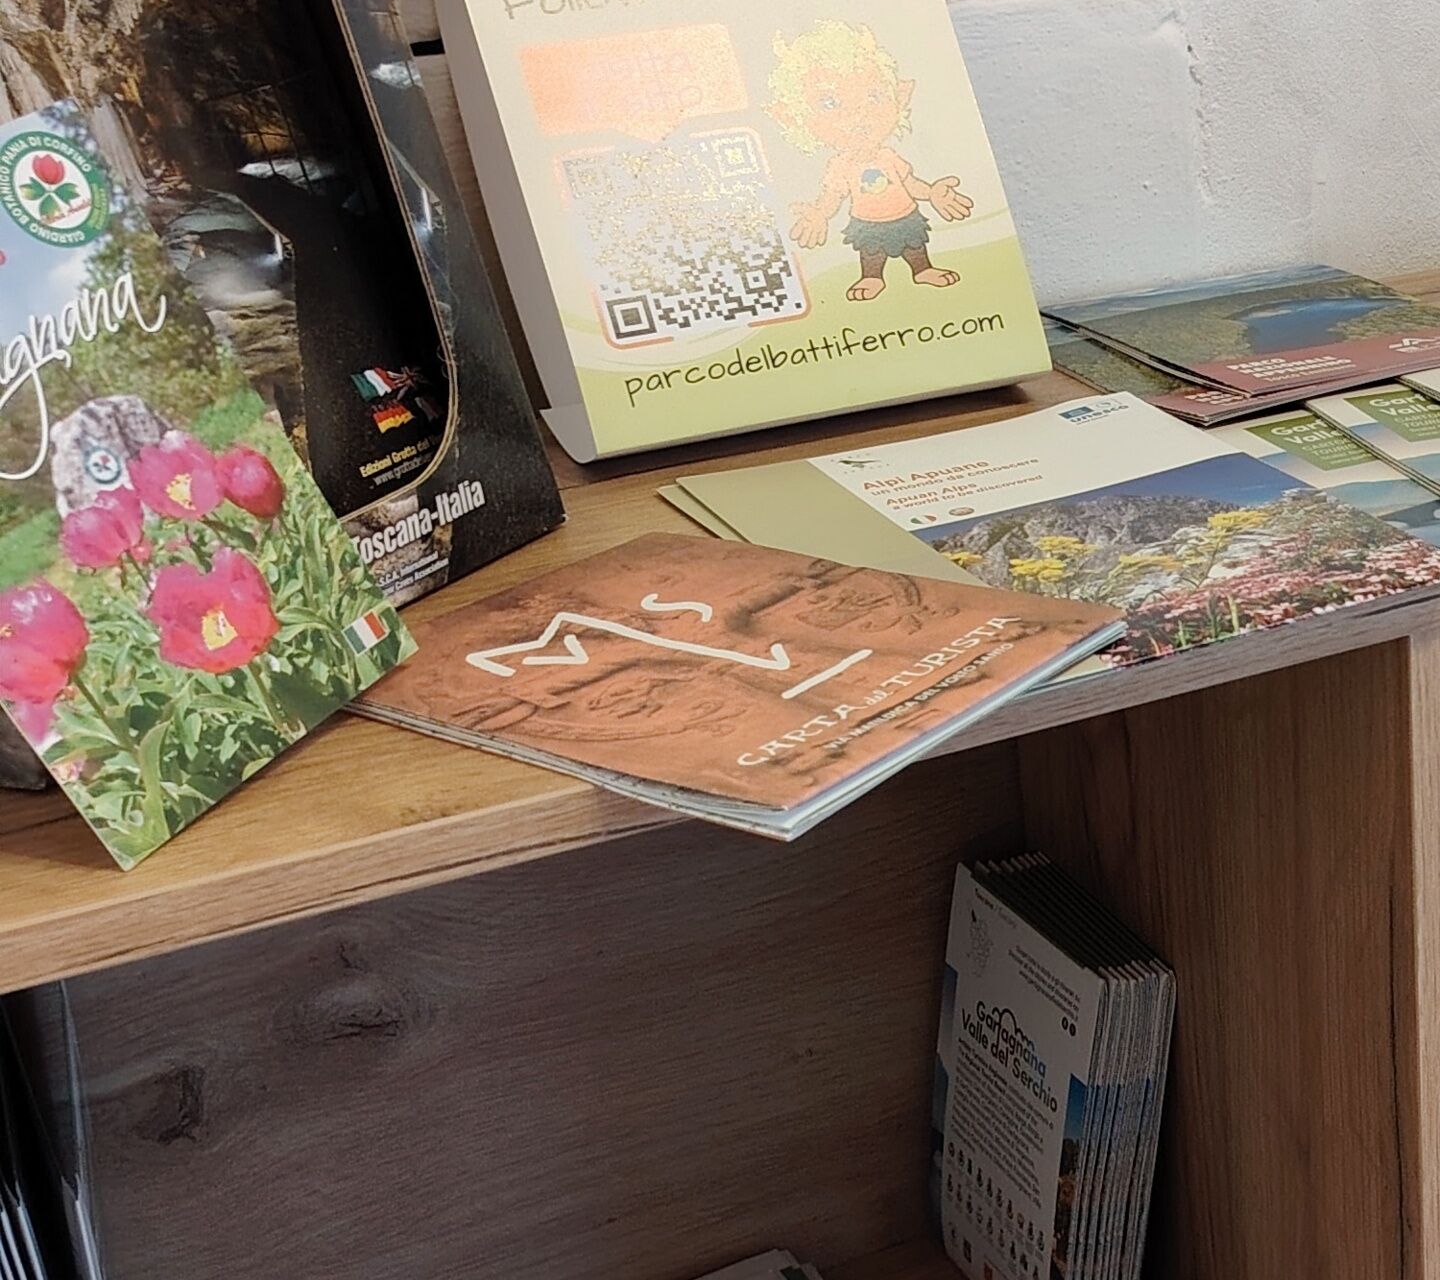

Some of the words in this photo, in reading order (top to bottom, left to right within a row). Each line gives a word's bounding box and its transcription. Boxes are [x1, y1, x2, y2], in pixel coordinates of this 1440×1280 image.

[3, 139, 29, 165] PANIA
[43, 137, 92, 173] CORFINO
[625, 309, 1006, 408] parcodelbattiferro.com
[863, 475, 905, 491] Alpi
[910, 460, 990, 484] Apuane
[886, 489, 937, 508] Apuan
[942, 480, 977, 498] Alps
[893, 477, 943, 495] mondo
[967, 458, 1040, 478] conoscere
[902, 496, 939, 510] world
[976, 473, 1043, 495] discovered
[736, 701, 869, 767] CARTA
[881, 614, 1022, 688] TURISTA
[823, 733, 852, 750] VIA
[913, 685, 942, 704] DEL
[940, 664, 978, 689] VOLTO
[976, 642, 1015, 668] SANTO
[961, 1007, 988, 1051] Valle
[989, 1038, 1010, 1069] del
[1012, 1058, 1058, 1114] Serchio
[976, 1000, 1047, 1080] Garfagnana
